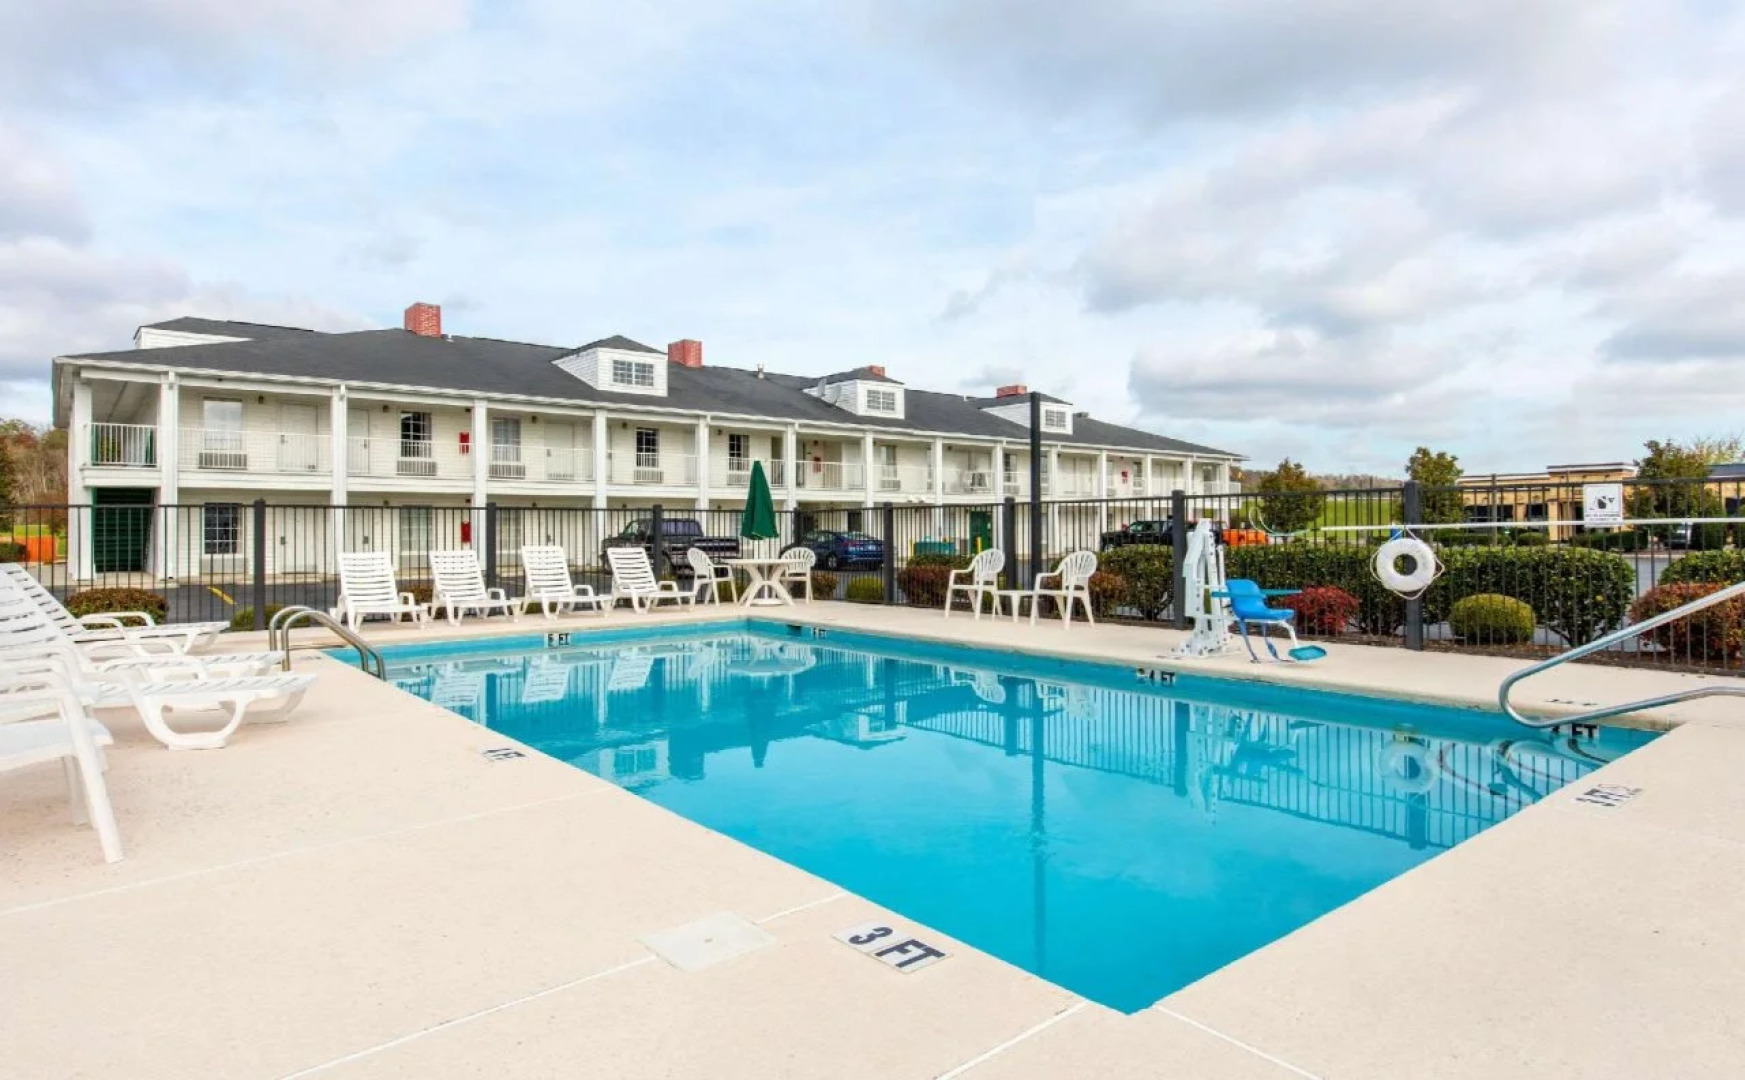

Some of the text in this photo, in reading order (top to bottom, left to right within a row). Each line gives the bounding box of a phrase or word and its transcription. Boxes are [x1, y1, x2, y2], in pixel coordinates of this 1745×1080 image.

[1572, 722, 1598, 739] FT
[849, 927, 946, 968] 3 FT
